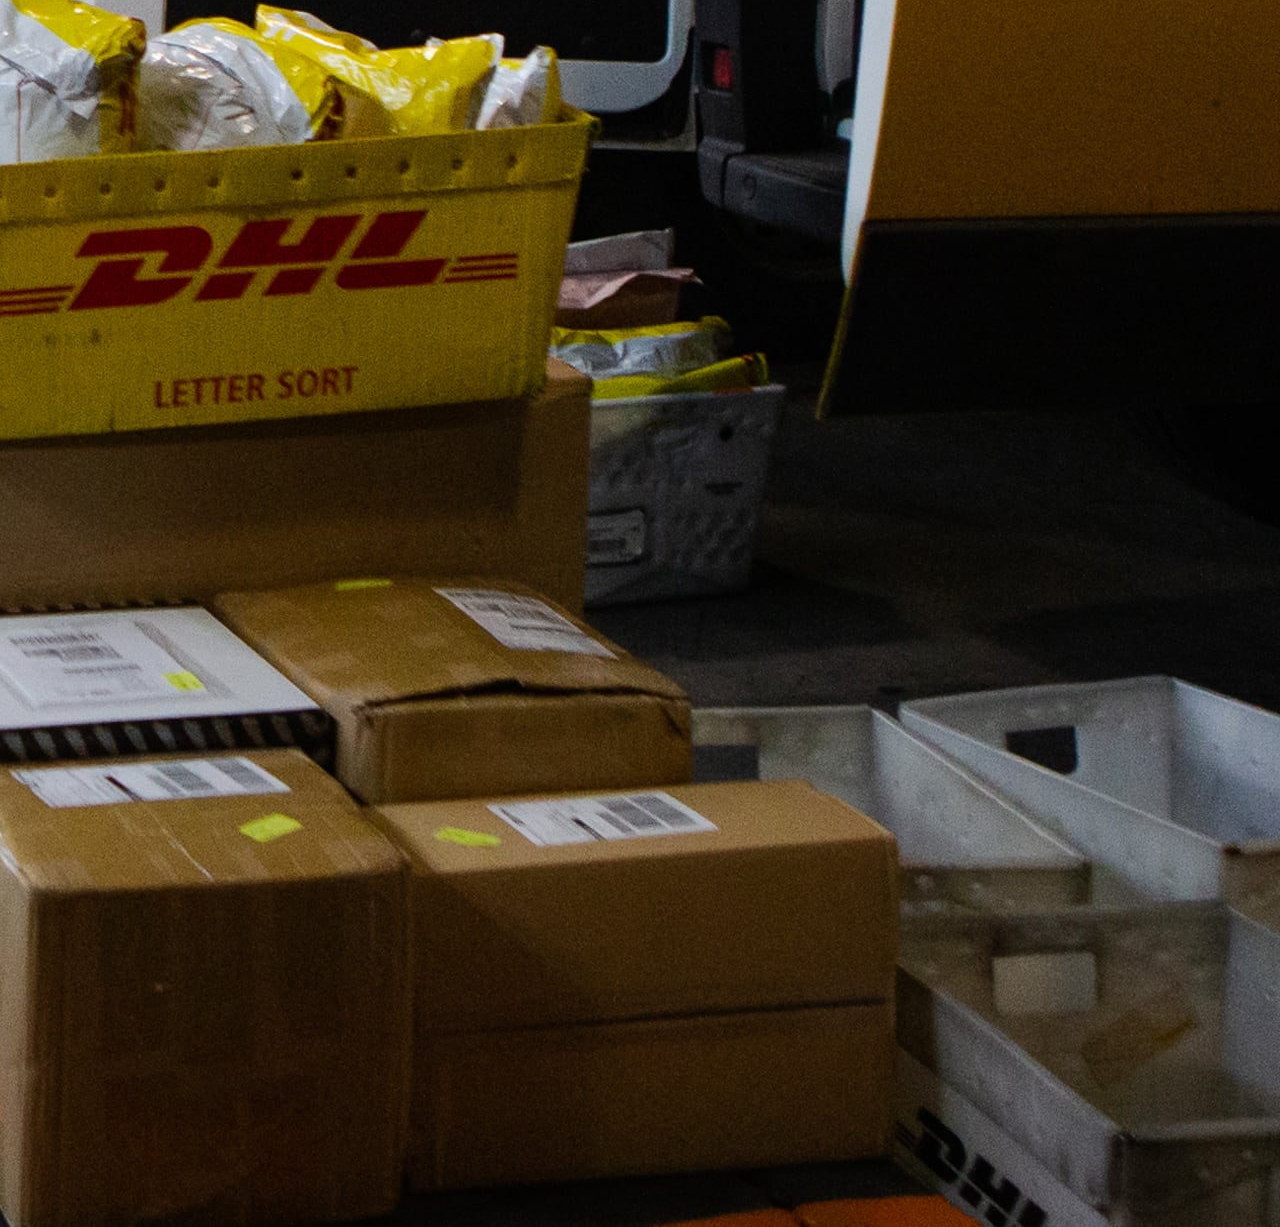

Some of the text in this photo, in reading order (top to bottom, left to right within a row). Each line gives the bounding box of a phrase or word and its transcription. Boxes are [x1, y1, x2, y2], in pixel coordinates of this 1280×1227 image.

[67, 210, 447, 312] DHL
[154, 367, 359, 410] LETTER SORT
